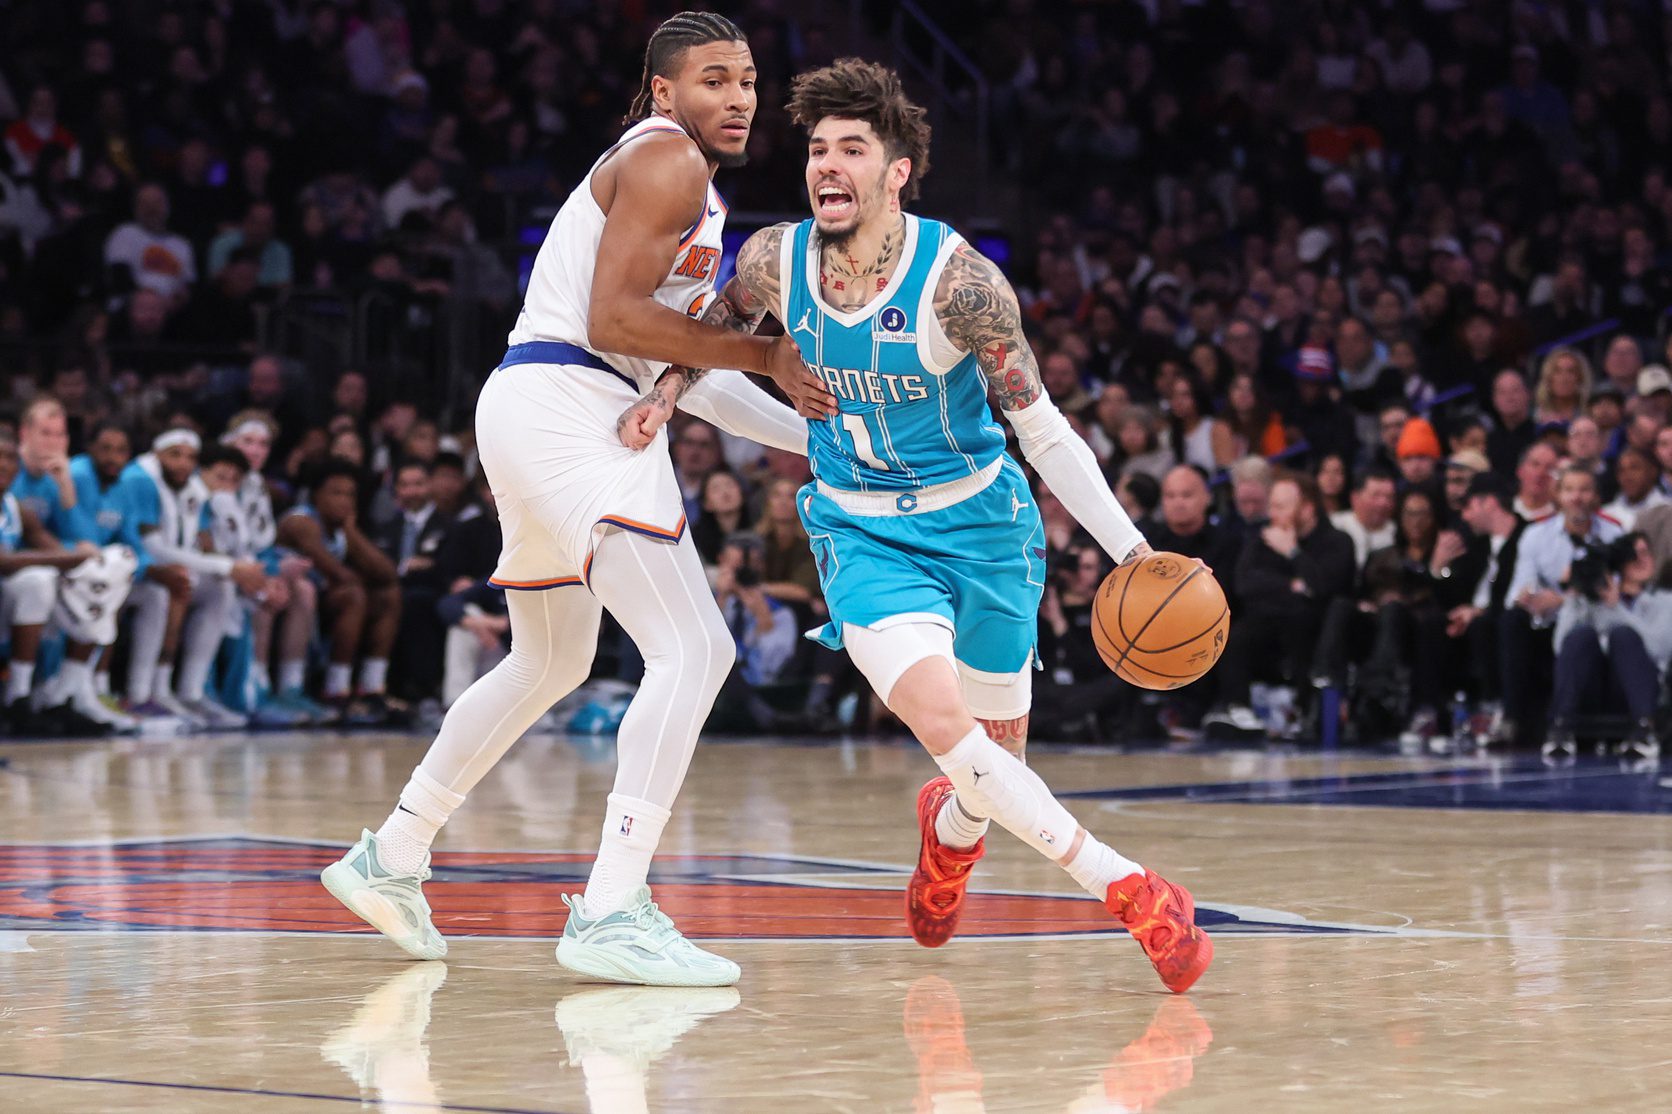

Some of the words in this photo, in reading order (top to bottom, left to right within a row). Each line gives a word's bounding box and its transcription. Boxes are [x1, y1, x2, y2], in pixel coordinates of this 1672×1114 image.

[874, 333, 891, 341] Judi
[891, 334, 916, 342] Health
[841, 412, 891, 471] 1
[896, 493, 917, 513] C
